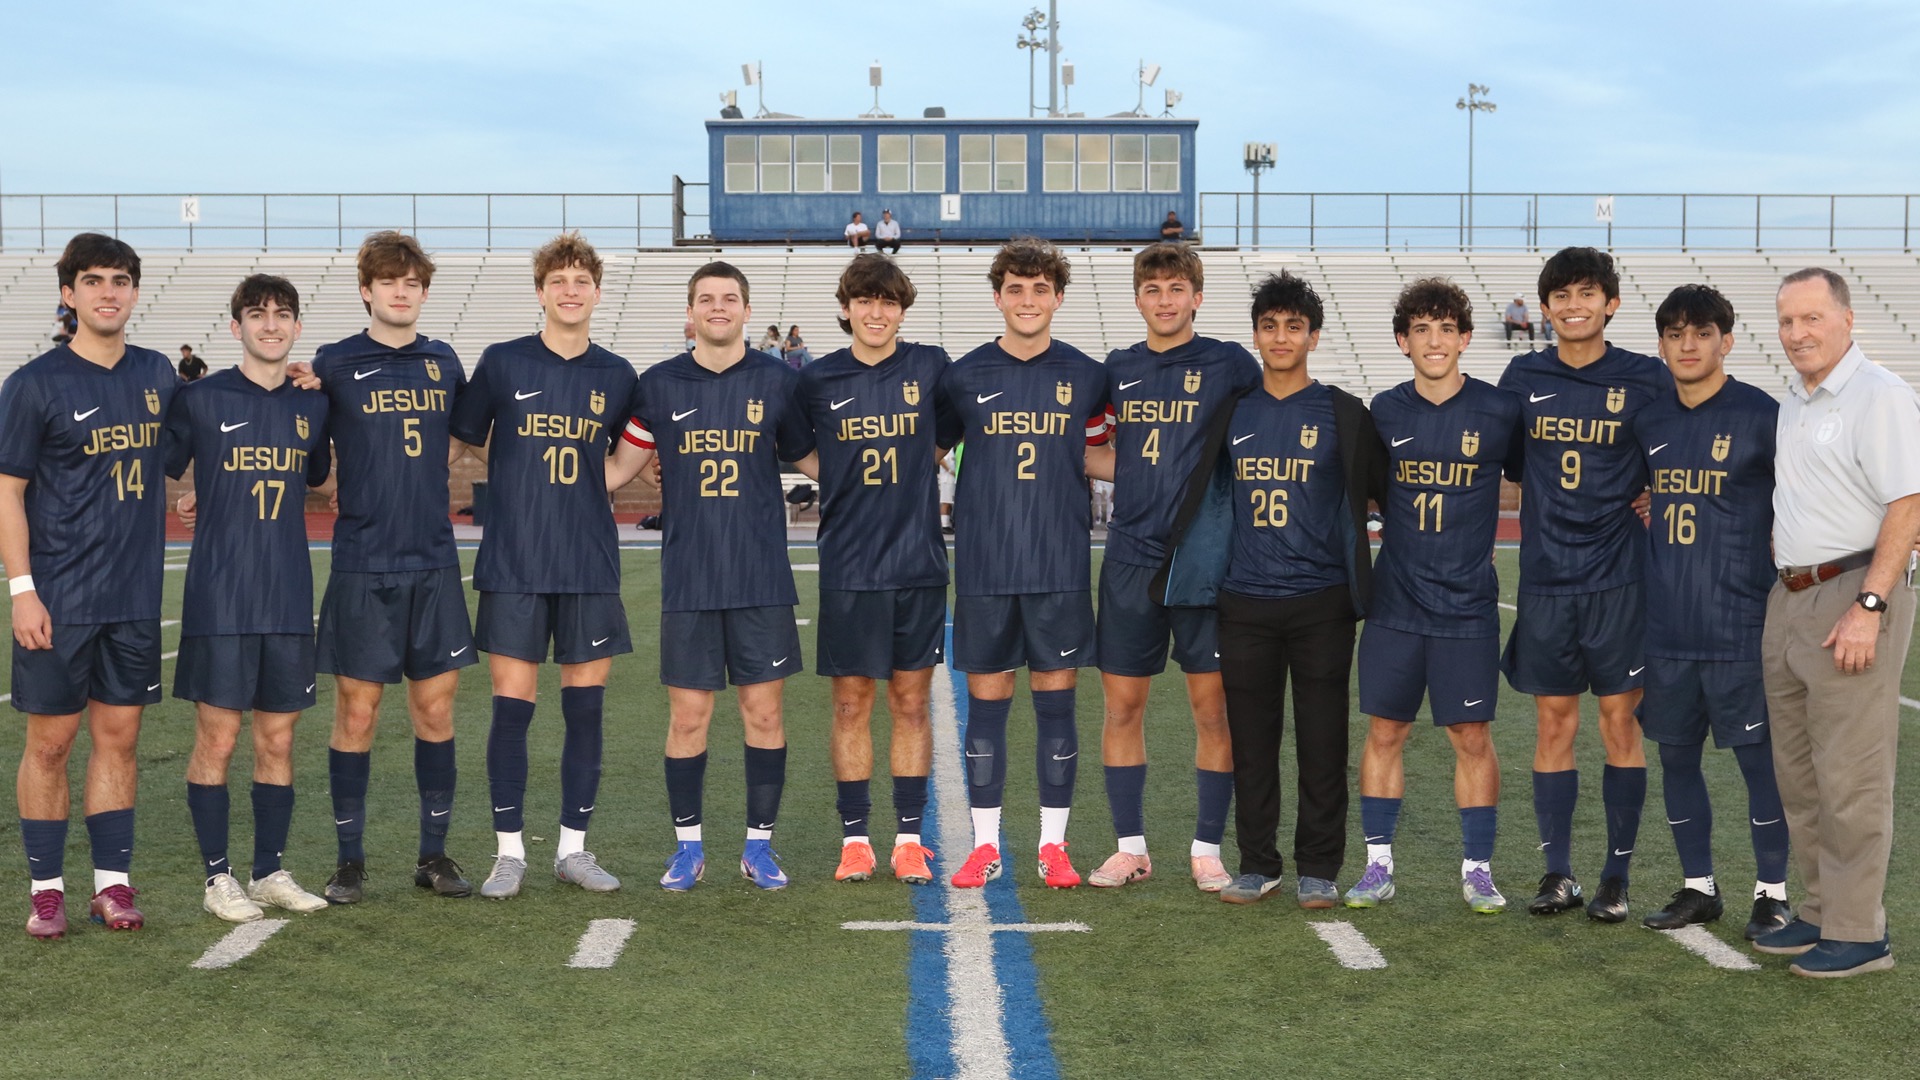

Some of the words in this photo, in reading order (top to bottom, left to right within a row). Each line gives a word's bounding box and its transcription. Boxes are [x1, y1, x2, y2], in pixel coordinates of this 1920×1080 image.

[185, 202, 196, 217] K
[947, 200, 956, 215] L
[1597, 203, 1611, 217] M
[362, 388, 447, 414] JESUIT
[1117, 400, 1199, 423] JESUIT
[84, 421, 161, 456] JESUIT
[403, 417, 422, 457] 5
[517, 413, 602, 444] JESUIT
[836, 412, 919, 442] JESUIT
[983, 411, 1071, 436] JESUIT
[1529, 416, 1622, 445] JESUIT
[678, 429, 761, 455] JESUIT
[1141, 428, 1160, 466] 4
[223, 445, 308, 474] JESUIT
[542, 445, 579, 485] 10
[862, 446, 898, 486] 21
[1017, 441, 1036, 480] 2
[1234, 457, 1315, 483] JESUIT
[1396, 460, 1479, 487] JESUIT
[1560, 450, 1581, 490] 9
[110, 458, 144, 502] 14
[699, 458, 739, 497] 22
[1652, 468, 1728, 496] JESUIT
[250, 479, 286, 521] 17
[1250, 488, 1288, 528] 26
[1412, 492, 1443, 533] 11
[1663, 503, 1696, 545] 16
